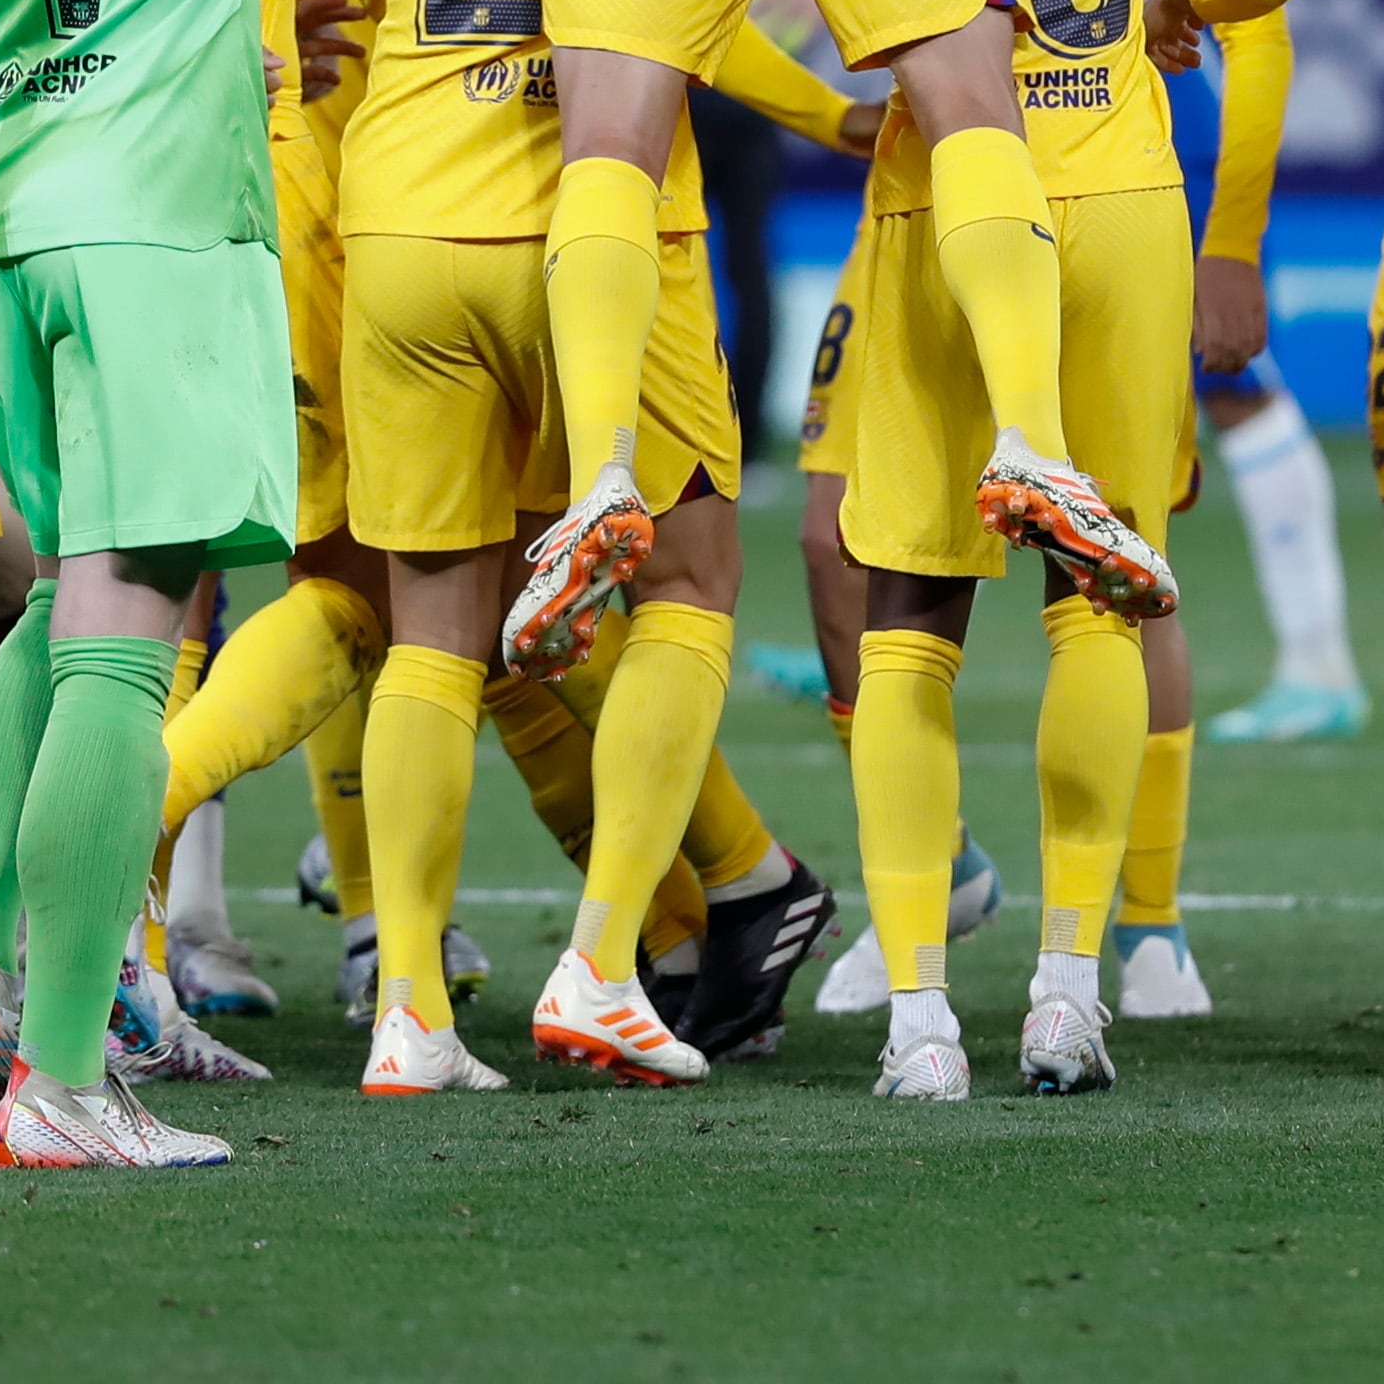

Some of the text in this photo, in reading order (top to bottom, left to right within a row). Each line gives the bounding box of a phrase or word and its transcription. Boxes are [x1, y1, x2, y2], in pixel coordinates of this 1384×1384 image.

[1024, 67, 1109, 88] UNHCR
[1024, 88, 1112, 108] ACNUR
[812, 303, 855, 389] 8
